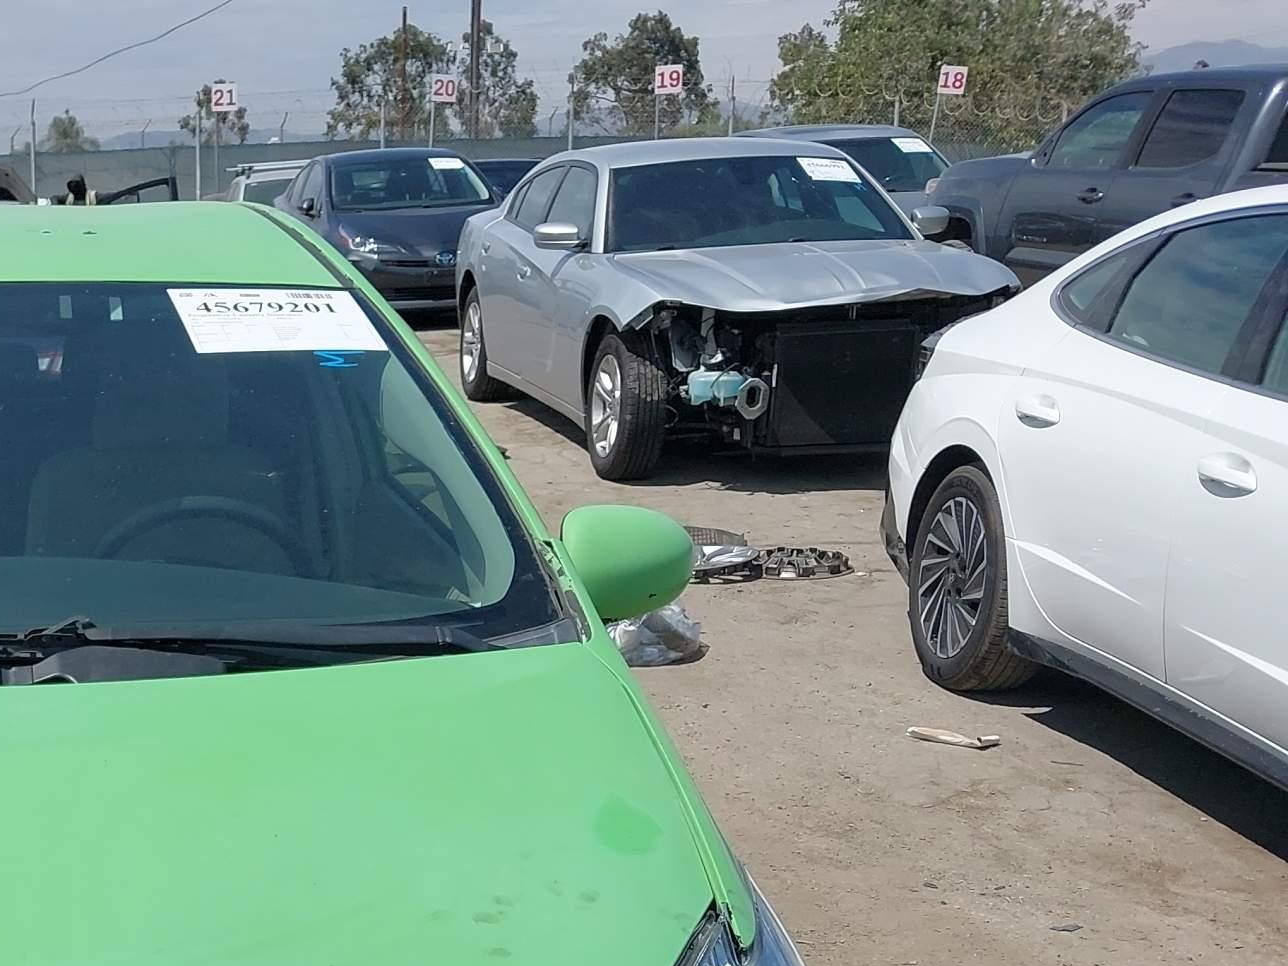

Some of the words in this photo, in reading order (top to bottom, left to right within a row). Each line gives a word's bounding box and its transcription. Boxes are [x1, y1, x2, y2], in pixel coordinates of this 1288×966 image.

[433, 79, 456, 96] 20
[656, 71, 680, 89] 19
[939, 72, 964, 89] 18
[213, 88, 237, 106] 21
[196, 301, 337, 314] 45679201
